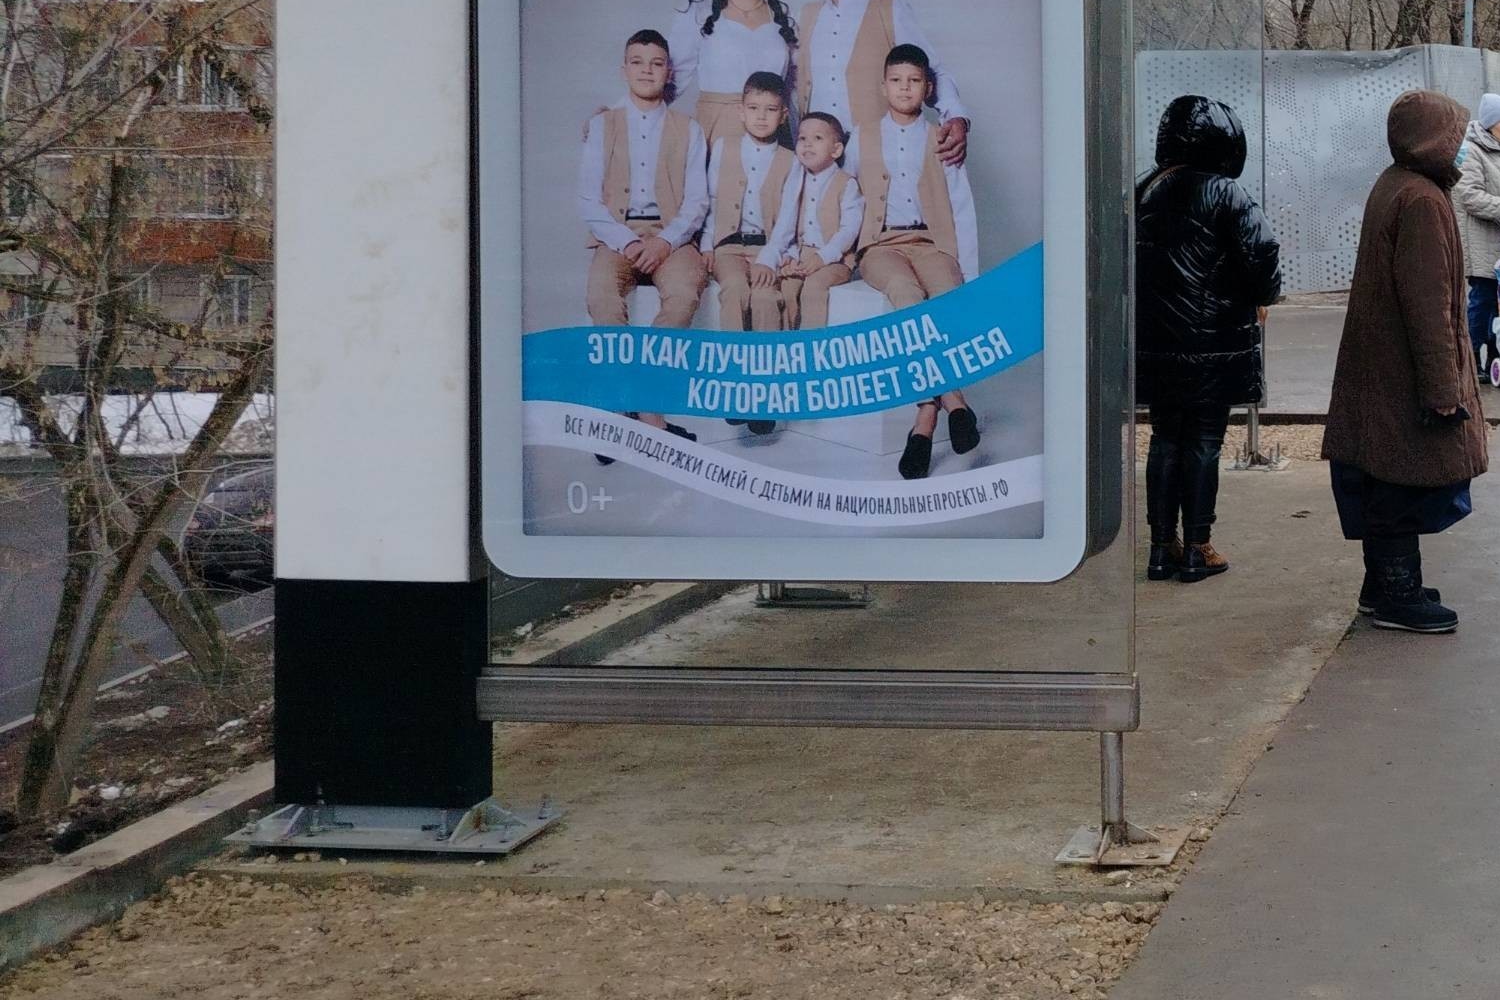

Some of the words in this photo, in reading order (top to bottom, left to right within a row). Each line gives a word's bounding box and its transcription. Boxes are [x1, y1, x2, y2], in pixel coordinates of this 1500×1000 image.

[588, 333, 635, 365] ЭТО
[641, 334, 692, 371] КАК
[696, 340, 807, 376] ЛУЧШАЯ
[813, 313, 949, 372] КОМАНДА,
[687, 376, 800, 414] КОТОРАЯ
[806, 366, 902, 412] БОЛЕЕТ
[907, 356, 946, 393] ЗА
[943, 326, 1013, 379] ТЕБЯ
[564, 414, 585, 436] ВСЕ
[588, 419, 623, 447] МЕРЫ
[625, 430, 704, 476] ПОДДЕРЖКИ
[705, 462, 748, 490] СЕМЕЙ
[749, 477, 759, 494] С
[758, 480, 815, 508] ДЕТЬМИ
[816, 491, 832, 511] НА
[567, 480, 613, 514] 0+
